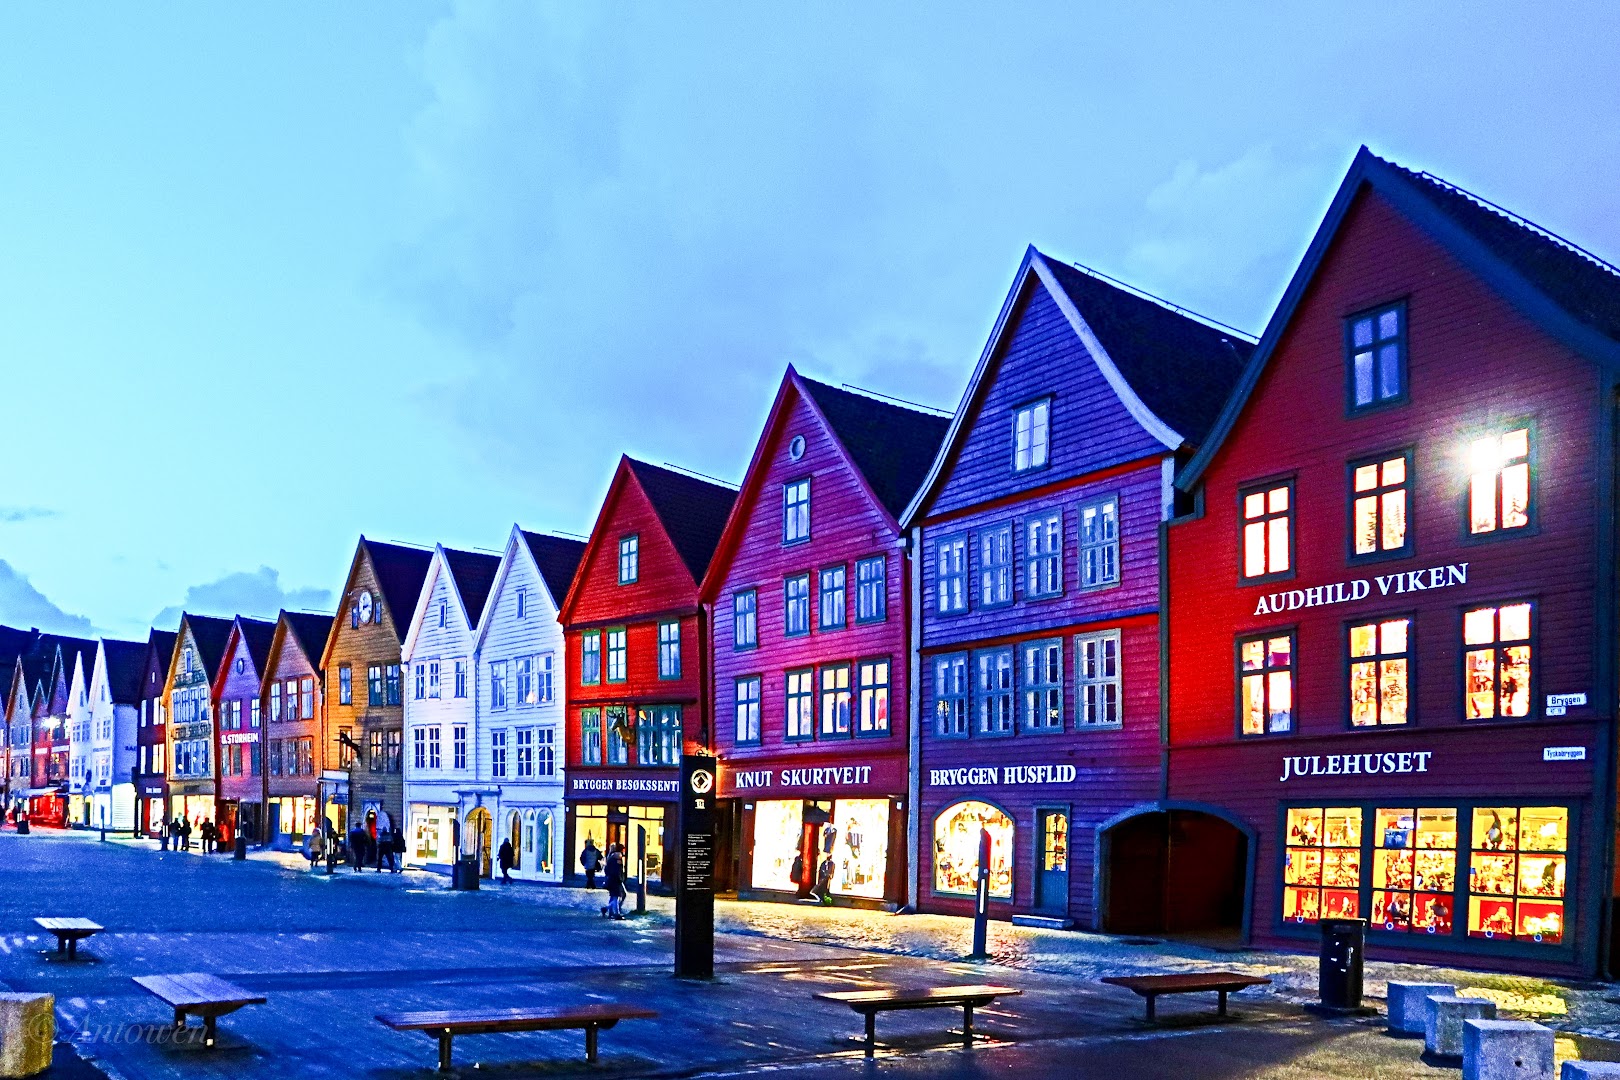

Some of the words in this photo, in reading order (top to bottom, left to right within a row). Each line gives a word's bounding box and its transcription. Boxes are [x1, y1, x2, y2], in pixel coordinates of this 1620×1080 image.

[1254, 579, 1370, 616] AUDHILD
[1375, 562, 1469, 597] VIKEN
[1551, 696, 1581, 706] Bryggen
[735, 770, 773, 788] KNUT
[781, 766, 872, 787] SKURTVEIT
[930, 767, 999, 786] BRYGGEN
[1004, 764, 1077, 784] HUSFLID
[1280, 751, 1432, 782] JULEHUSET
[573, 779, 613, 790] BRYGGEN
